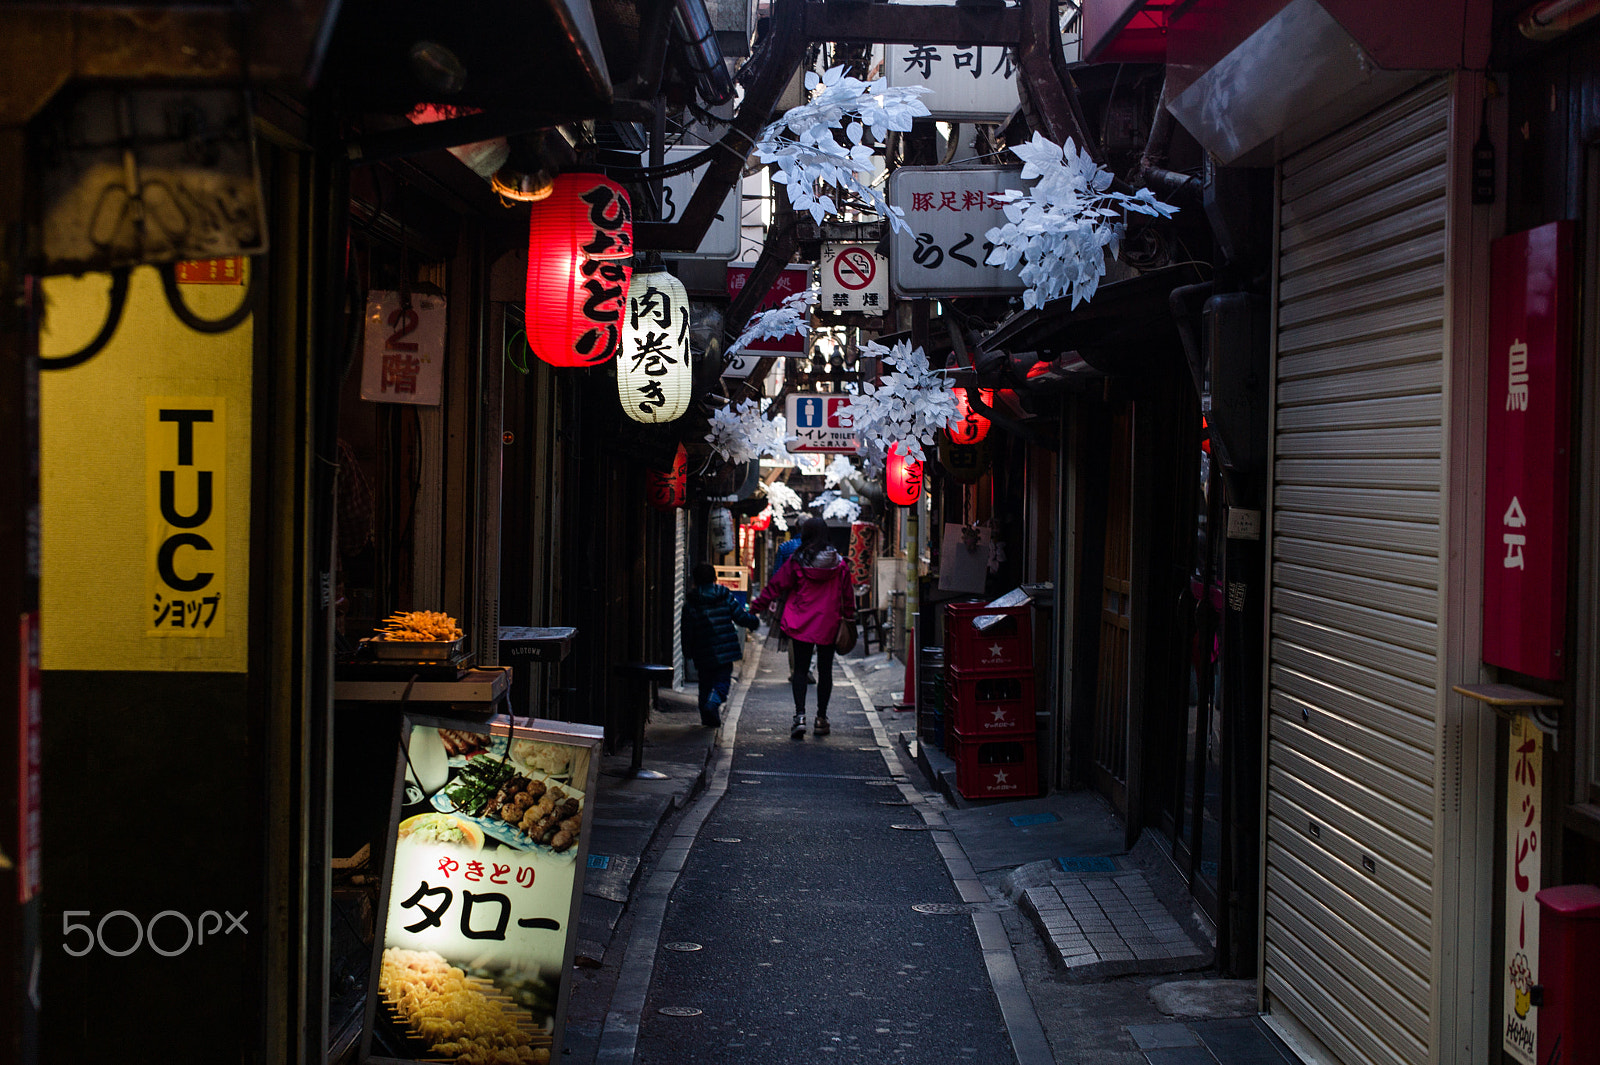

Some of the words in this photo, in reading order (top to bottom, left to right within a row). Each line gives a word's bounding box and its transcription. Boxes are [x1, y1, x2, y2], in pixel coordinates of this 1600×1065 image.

[574, 183, 632, 362] ひなどり
[833, 293, 878, 306] 禁煙
[381, 306, 420, 394] 2階
[630, 286, 678, 414] 肉巻き
[795, 429, 827, 440] トイレ
[831, 432, 855, 440] TOILET
[157, 408, 215, 592] TUC
[152, 592, 221, 629] ショップ
[511, 647, 542, 656] OLDTOWN
[1514, 719, 1537, 949] ホッピー
[437, 856, 536, 889] やきとり
[400, 880, 561, 941] タロー
